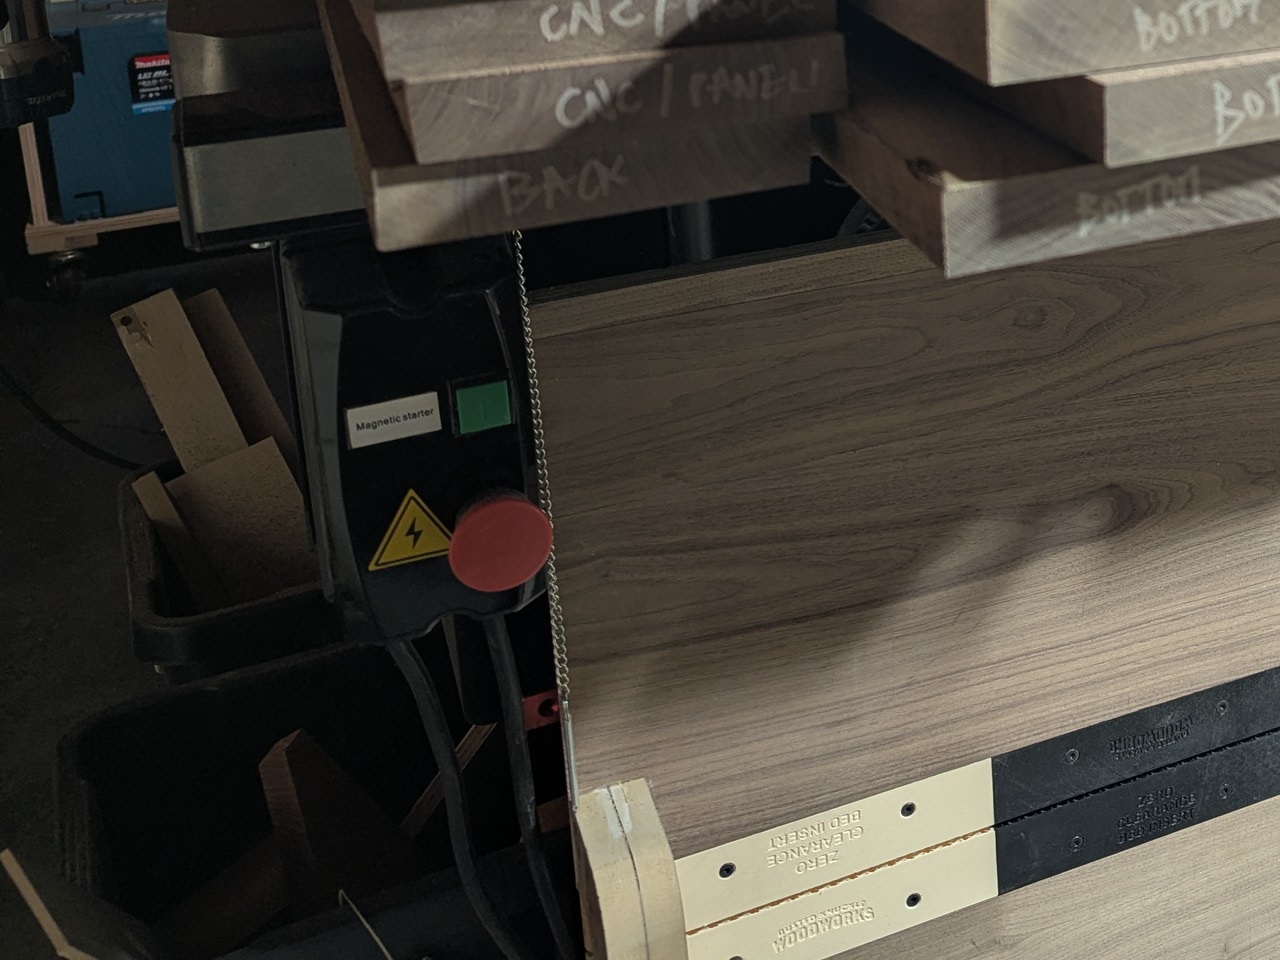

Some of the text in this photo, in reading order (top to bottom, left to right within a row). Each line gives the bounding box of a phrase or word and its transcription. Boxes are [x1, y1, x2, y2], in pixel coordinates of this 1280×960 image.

[355, 407, 435, 432] Magnetic starter
[765, 809, 862, 852] BED INSERT
[766, 826, 865, 868] CLEARANCE
[794, 850, 839, 875] ZERO
[772, 906, 876, 954] WOODWORKS
